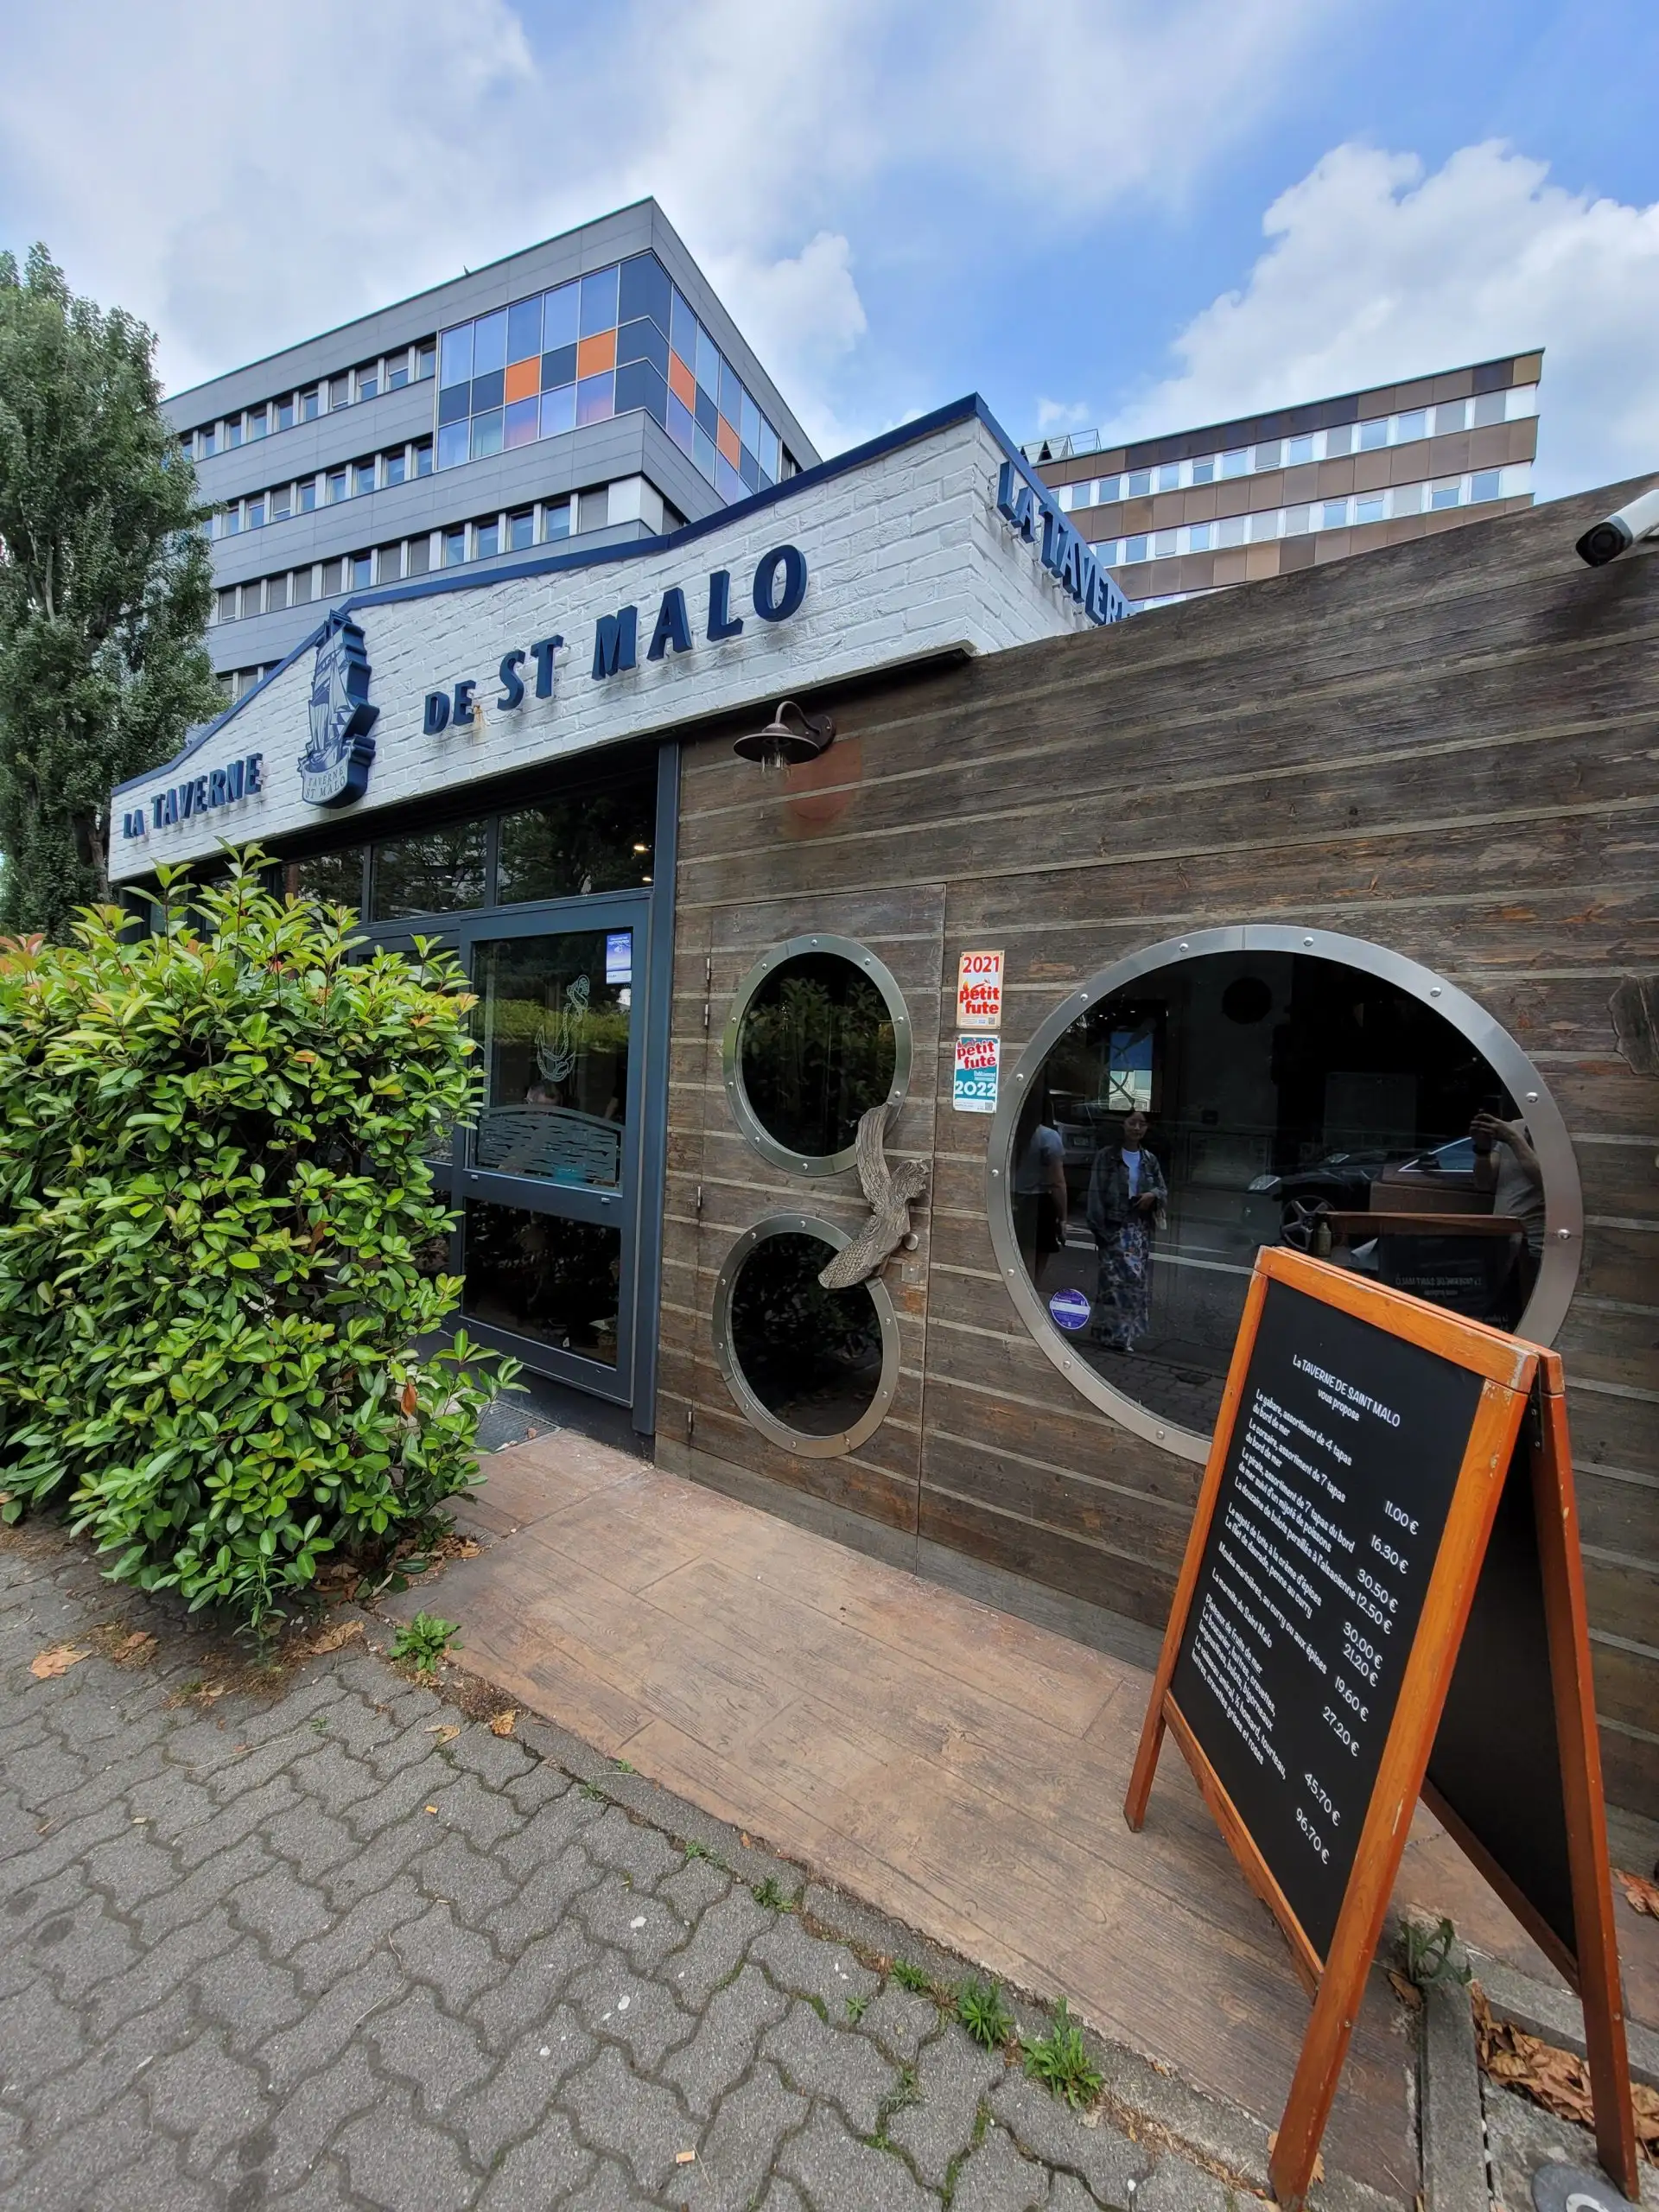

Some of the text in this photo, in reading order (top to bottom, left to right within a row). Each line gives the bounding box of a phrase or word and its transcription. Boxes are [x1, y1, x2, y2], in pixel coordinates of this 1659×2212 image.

[997, 461, 1035, 543] LA
[124, 544, 807, 839] LA TAVERNE DE ST MALO
[305, 776, 346, 799] ST MALO
[308, 766, 344, 787] TAVERNE
[963, 956, 1000, 974] 2021
[959, 986, 1000, 1004] petit
[957, 1040, 995, 1060] petit
[955, 1080, 996, 1097] 2022
[1293, 1354, 1401, 1427] La TAVERNE DE SAINT MALO
[1318, 1389, 1360, 1421] vous propose
[1252, 1402, 1291, 1437] du bord de mer
[1255, 1388, 1264, 1402] Le
[1282, 1411, 1317, 1440] assortiment
[1316, 1433, 1325, 1446] de
[1325, 1440, 1333, 1452] 4
[1332, 1445, 1352, 1466] tapas
[1245, 1432, 1283, 1468] du bord de mer
[1249, 1417, 1256, 1431] Le
[1278, 1444, 1313, 1475] assortiment
[1312, 1468, 1320, 1483] de
[1320, 1473, 1328, 1486] 7
[1326, 1480, 1346, 1503] tapas
[1238, 1461, 1246, 1473] de
[1244, 1468, 1255, 1482] mer
[1295, 1513, 1305, 1528] de
[1302, 1522, 1332, 1553] poissons
[1242, 1446, 1249, 1460] Le
[1264, 1470, 1297, 1502] assortiment
[1296, 1495, 1305, 1510] de
[1305, 1500, 1313, 1513] 7
[1311, 1508, 1329, 1531] tapas
[1328, 1523, 1338, 1539] du
[1337, 1529, 1356, 1554] bord
[1384, 1500, 1420, 1535] 11.00 €
[1228, 1502, 1236, 1516] Le
[1249, 1525, 1257, 1539] de
[1255, 1530, 1268, 1551] lotte
[1268, 1543, 1273, 1556] à
[1272, 1547, 1279, 1562] la
[1278, 1557, 1297, 1580] crème
[1234, 1476, 1243, 1491] La
[1241, 1484, 1264, 1511] douzaine
[1263, 1504, 1271, 1518] de
[1270, 1510, 1288, 1534] bulots
[1312, 1550, 1318, 1563] à
[1357, 1592, 1383, 1624] 12.50
[1383, 1619, 1393, 1635] €
[1370, 1535, 1409, 1574] 16.30 €
[1224, 1515, 1232, 1529] Le
[1241, 1534, 1249, 1547] de
[1268, 1565, 1287, 1589] penne
[1287, 1585, 1296, 1599] au
[1294, 1593, 1313, 1619] curry
[1357, 1568, 1398, 1613] 30.50 €
[1202, 1606, 1209, 1621] Le
[1211, 1567, 1273, 1648] La marmite du Saint Malo
[1218, 1541, 1236, 1567] Moules
[1262, 1595, 1271, 1608] au
[1269, 1604, 1287, 1629] curry
[1285, 1622, 1294, 1636] ou
[1294, 1631, 1306, 1650] aux
[1306, 1643, 1327, 1675] épices
[1205, 1593, 1263, 1674] Plateaux de fruits de mer
[1343, 1622, 1383, 1669] 30.00 €
[1343, 1643, 1378, 1688] 21.20 €
[1194, 1635, 1202, 1650] Le
[1239, 1701, 1261, 1741] homard,
[1261, 1734, 1286, 1780] tourteau,
[1206, 1675, 1228, 1710] crevettes
[1226, 1707, 1243, 1732] grises
[1242, 1729, 1249, 1741] et
[1248, 1738, 1264, 1765] roses
[1243, 1681, 1274, 1732] bigorneaux
[1335, 1675, 1369, 1722] 19.60 €
[1322, 1706, 1360, 1757] 27.20 €
[1304, 1773, 1341, 1827] 45.70 €
[1296, 1808, 1330, 1865] 96.70 €
